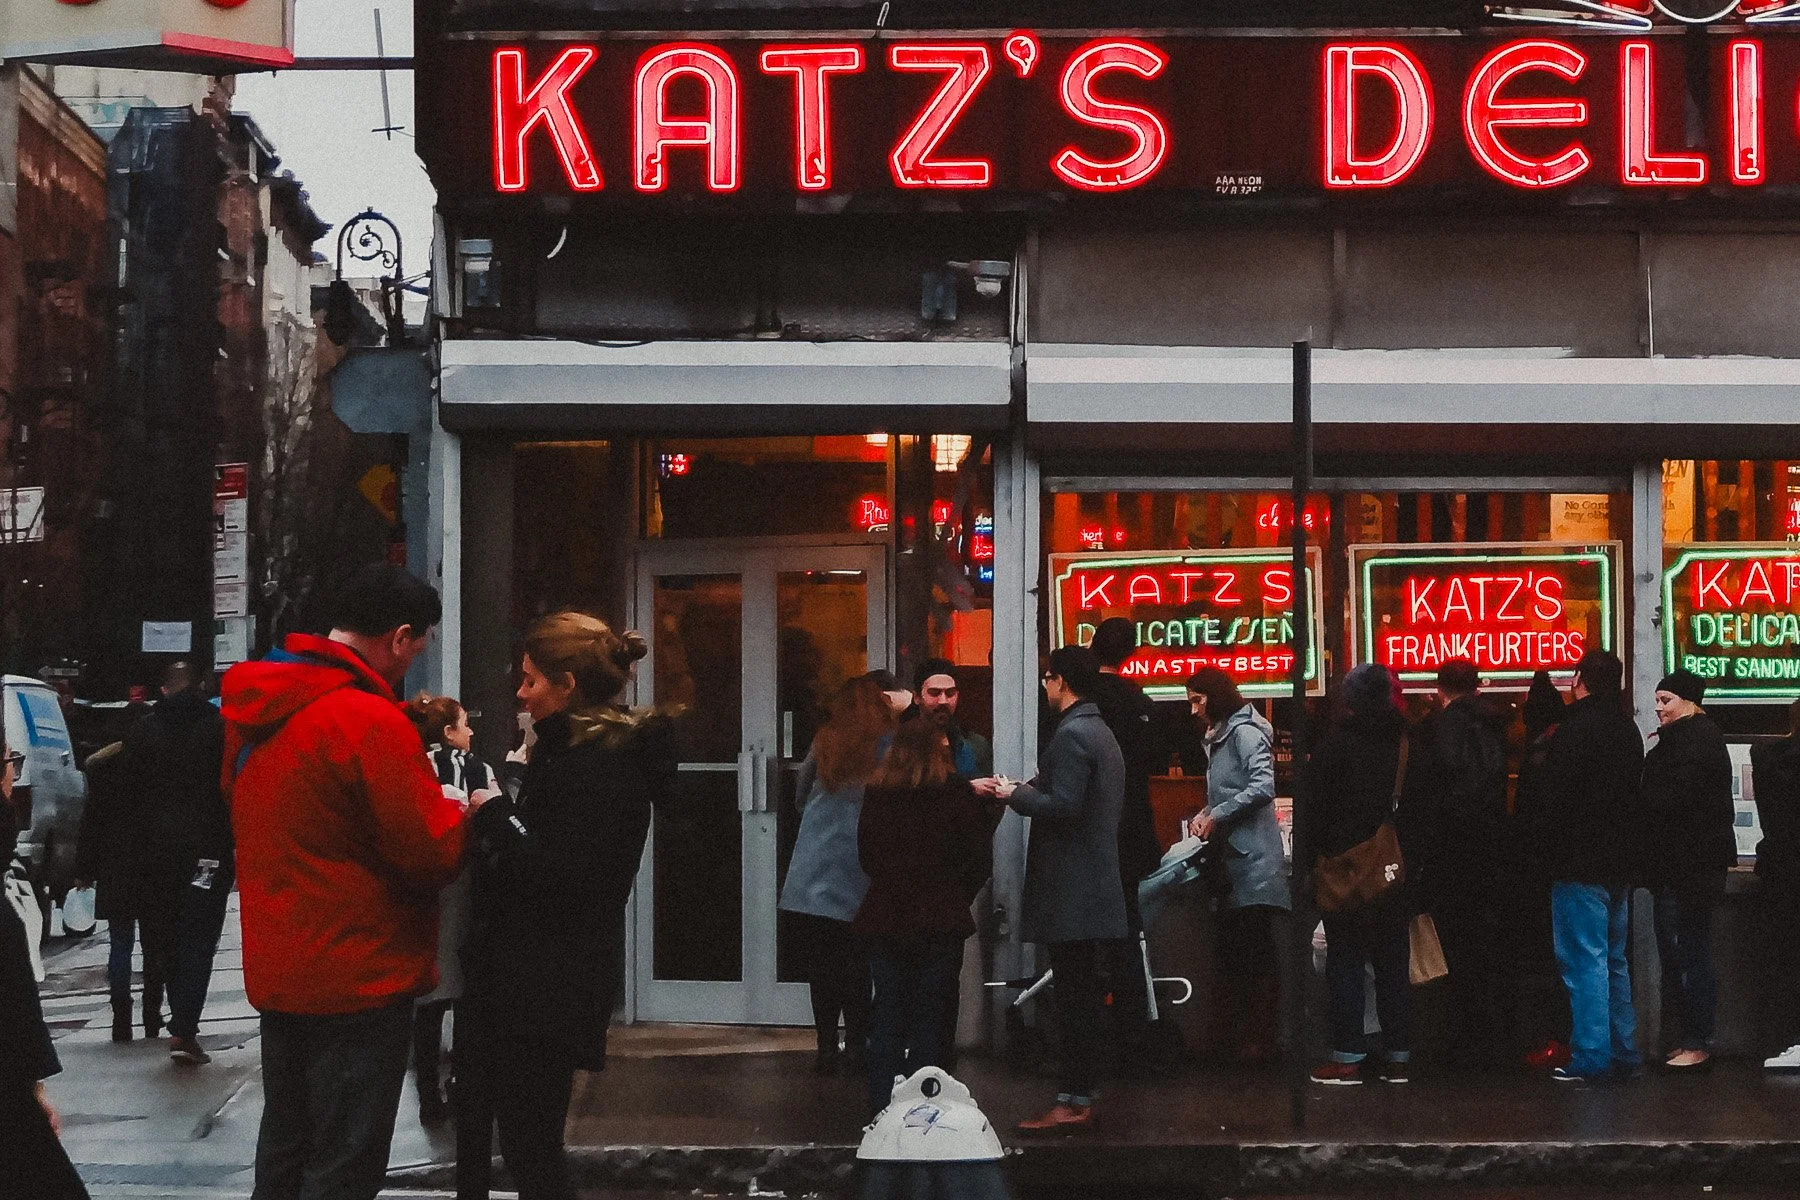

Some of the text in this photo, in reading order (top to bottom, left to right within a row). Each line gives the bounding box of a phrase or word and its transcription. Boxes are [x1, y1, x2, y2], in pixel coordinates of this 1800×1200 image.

[491, 30, 1768, 195] KATZ'S DELI
[1410, 571, 1563, 623] KATZ'S
[1234, 655, 1293, 672] BEST
[1386, 631, 1585, 666] FRANKFURTERS
[1684, 655, 1731, 678] BEST
